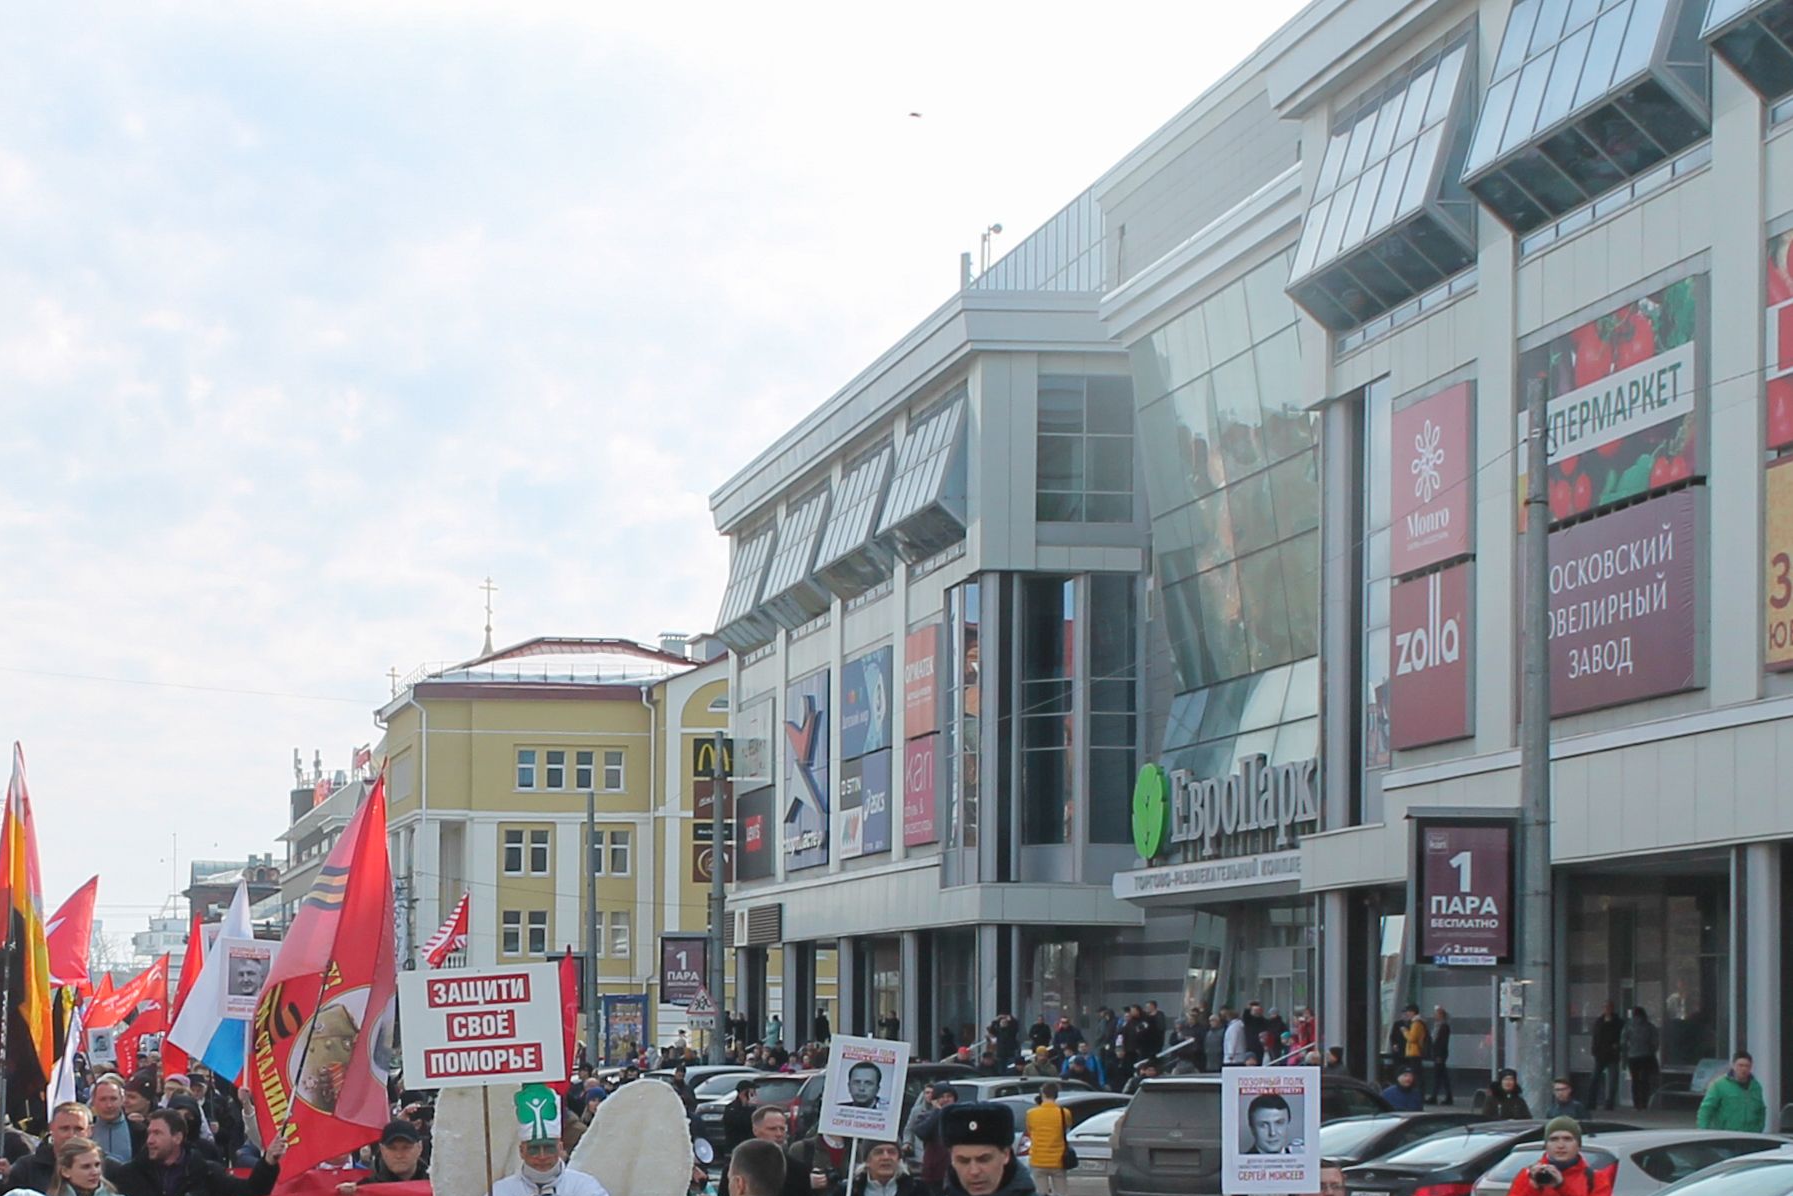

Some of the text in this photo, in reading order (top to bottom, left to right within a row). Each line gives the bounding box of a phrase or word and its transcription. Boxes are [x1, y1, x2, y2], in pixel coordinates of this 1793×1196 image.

[1548, 361, 1682, 446] ПЕРМАРКЕТ
[1407, 507, 1450, 538] Monro
[1549, 522, 1673, 595] ОСКОВСКИЙ
[1396, 572, 1459, 676] zolla
[1568, 637, 1633, 679] ЗАВОД
[1170, 753, 1318, 856] ЕвроПарк
[1261, 855, 1302, 876] КОМПЛЕ
[1449, 851, 1472, 893] 1
[1431, 896, 1498, 915] ПАРА
[1431, 918, 1499, 929] БЕСПЛАТНО
[676, 950, 687, 971] 1
[667, 971, 699, 981] ПАРА
[433, 978, 525, 1005] ЗАЩИТИ
[453, 1009, 510, 1038] СВОЁ
[430, 1047, 536, 1074] ПОМОРЬЕ
[1238, 1076, 1304, 1087] ПОЗОРНЫЙ ПОЛК
[1238, 1169, 1266, 1181] СЕРГЕЙ
